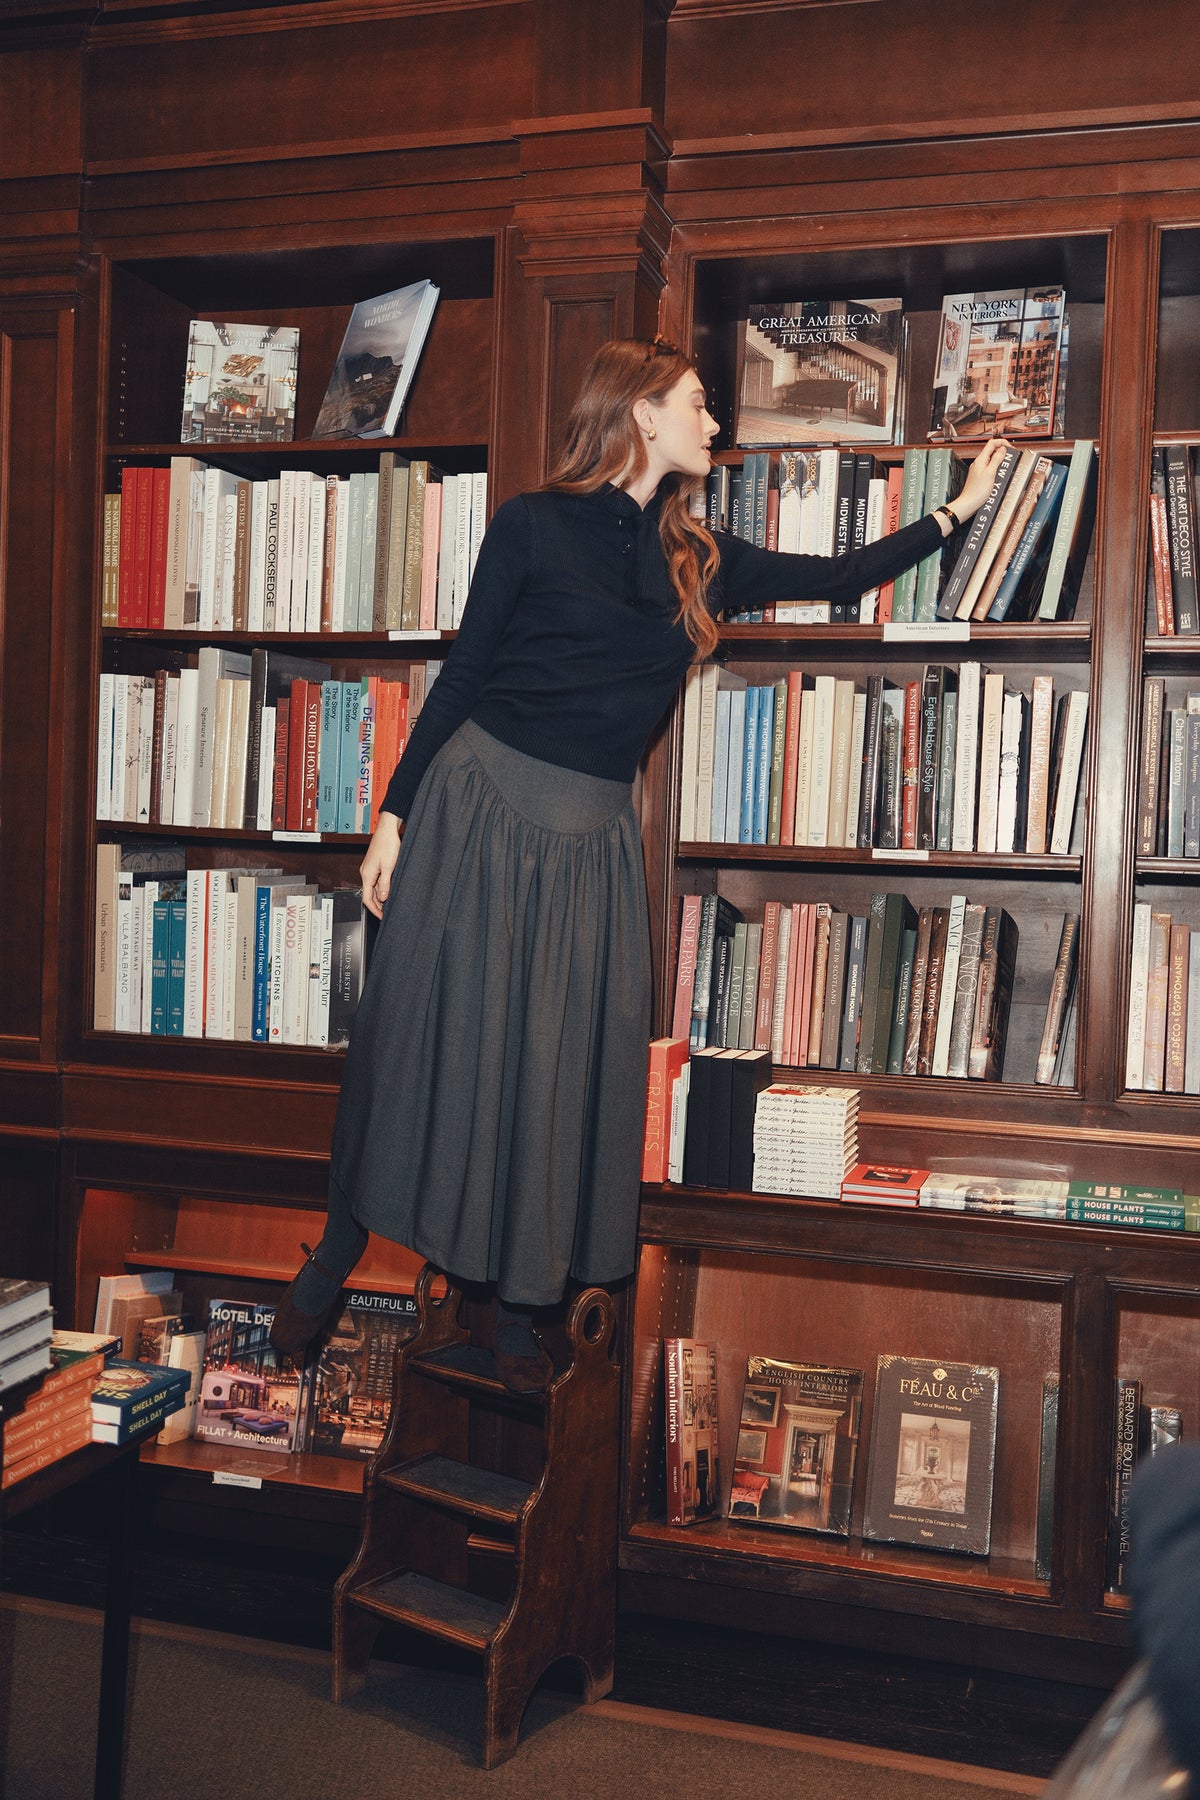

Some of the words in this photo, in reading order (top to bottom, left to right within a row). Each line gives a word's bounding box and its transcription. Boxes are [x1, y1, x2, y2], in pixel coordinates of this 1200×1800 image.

[952, 303, 978, 313] NEW
[984, 300, 1016, 310] YORK
[959, 311, 1008, 320] INTERIORS
[760, 317, 804, 329] GREAT
[807, 314, 881, 326] AMERICAN
[780, 331, 857, 344] TREASURES
[910, 458, 918, 477] NEW
[933, 458, 942, 477] NEW
[998, 453, 1013, 477] NEW
[380, 467, 389, 502] PORTRAITS
[459, 482, 467, 512] REFINED
[908, 477, 917, 499] YORK
[932, 477, 940, 499] YORK
[984, 482, 1002, 511] YORK
[1176, 475, 1186, 494] THE
[269, 503, 277, 532] PAUL
[380, 504, 388, 513] OF
[906, 502, 916, 526] SPLEN
[1062, 486, 1078, 527] Summer
[1170, 498, 1178, 529] Designers
[1177, 496, 1186, 514] ART
[238, 529, 244, 539] IN
[839, 497, 849, 543] MIDWEST
[855, 499, 865, 544] MIDWEST
[889, 515, 898, 535] YOR
[968, 515, 987, 551] STYLE
[1058, 529, 1068, 539] by
[1179, 517, 1189, 548] DECO
[378, 545, 386, 561] DISC
[1056, 540, 1066, 557] the
[1172, 537, 1180, 571] Collectors
[266, 535, 276, 607] COCKSEDGE
[1051, 559, 1062, 576] Sea
[1181, 550, 1191, 577] STYLE
[377, 563, 385, 598] INTERIORS
[200, 707, 208, 738] Signature
[253, 700, 261, 748] SOPHISTICATED
[308, 703, 317, 748] STORIED
[749, 717, 755, 728] AT
[926, 697, 937, 733] English
[361, 707, 372, 764] DEFINING
[774, 734, 782, 754] British
[1175, 718, 1184, 743] Chair
[773, 755, 781, 771] Taste
[836, 752, 844, 777] D'AZUR
[925, 734, 934, 766] House
[306, 751, 315, 789] HOMES
[923, 767, 933, 793] Style
[1172, 745, 1183, 786] Anatomy
[359, 768, 369, 804] STYLE
[286, 905, 296, 949] WOOD
[683, 904, 697, 948] INSIDE
[767, 907, 776, 925] THE
[947, 904, 963, 953] VENICE
[258, 912, 266, 951] Waterfront
[275, 913, 284, 953] Uncommon
[765, 927, 774, 964] LONDON
[984, 917, 996, 954] WILTON
[257, 953, 265, 975] House
[322, 938, 332, 965] Where
[344, 935, 352, 970] WORLD'S
[121, 944, 129, 993] BALBIANO
[273, 956, 281, 1000] KITCHENS
[320, 968, 331, 987] They
[680, 950, 692, 986] PARIS
[733, 966, 741, 982] LA
[746, 967, 755, 982] LA
[762, 966, 772, 989] CLUB
[849, 964, 858, 997] SIGNATURE
[955, 931, 983, 1004] VENICE
[982, 958, 992, 992] HOUSE
[321, 989, 330, 1007] Purr
[830, 964, 838, 1005] SCOTLAND
[1174, 956, 1183, 1016] ÉGYPTOMANIE
[730, 985, 740, 1017] FOCE
[744, 986, 754, 1017] FOCE
[848, 998, 856, 1022] HOUSES
[645, 1072, 661, 1151] CRAFTS
[867, 1166, 919, 1174] EAMES
[1084, 1201, 1111, 1210] HOUSE
[1113, 1204, 1145, 1213] PLANTS
[1084, 1211, 1111, 1221] HOUSE
[1113, 1214, 1144, 1224] PLANTS
[211, 1308, 252, 1324] HOTEL
[668, 1350, 678, 1397] Southern
[766, 1369, 804, 1380] ENGLISH
[807, 1374, 849, 1385] COUNTRY
[769, 1377, 798, 1386] HOUSE
[801, 1381, 848, 1393] INTERIORS
[132, 1398, 153, 1415] SHELL
[154, 1390, 168, 1403] DAY
[899, 1378, 943, 1397] FÉAU
[946, 1385, 958, 1400] &
[129, 1417, 150, 1434] SHELL
[151, 1408, 163, 1421] DAY
[669, 1400, 678, 1444] Interiors
[1123, 1388, 1135, 1441] BERNARD
[197, 1425, 225, 1437] FILLAT
[234, 1431, 288, 1446] Architecture
[1122, 1443, 1133, 1486] BOUTET
[1119, 1506, 1130, 1556] MONVEL
